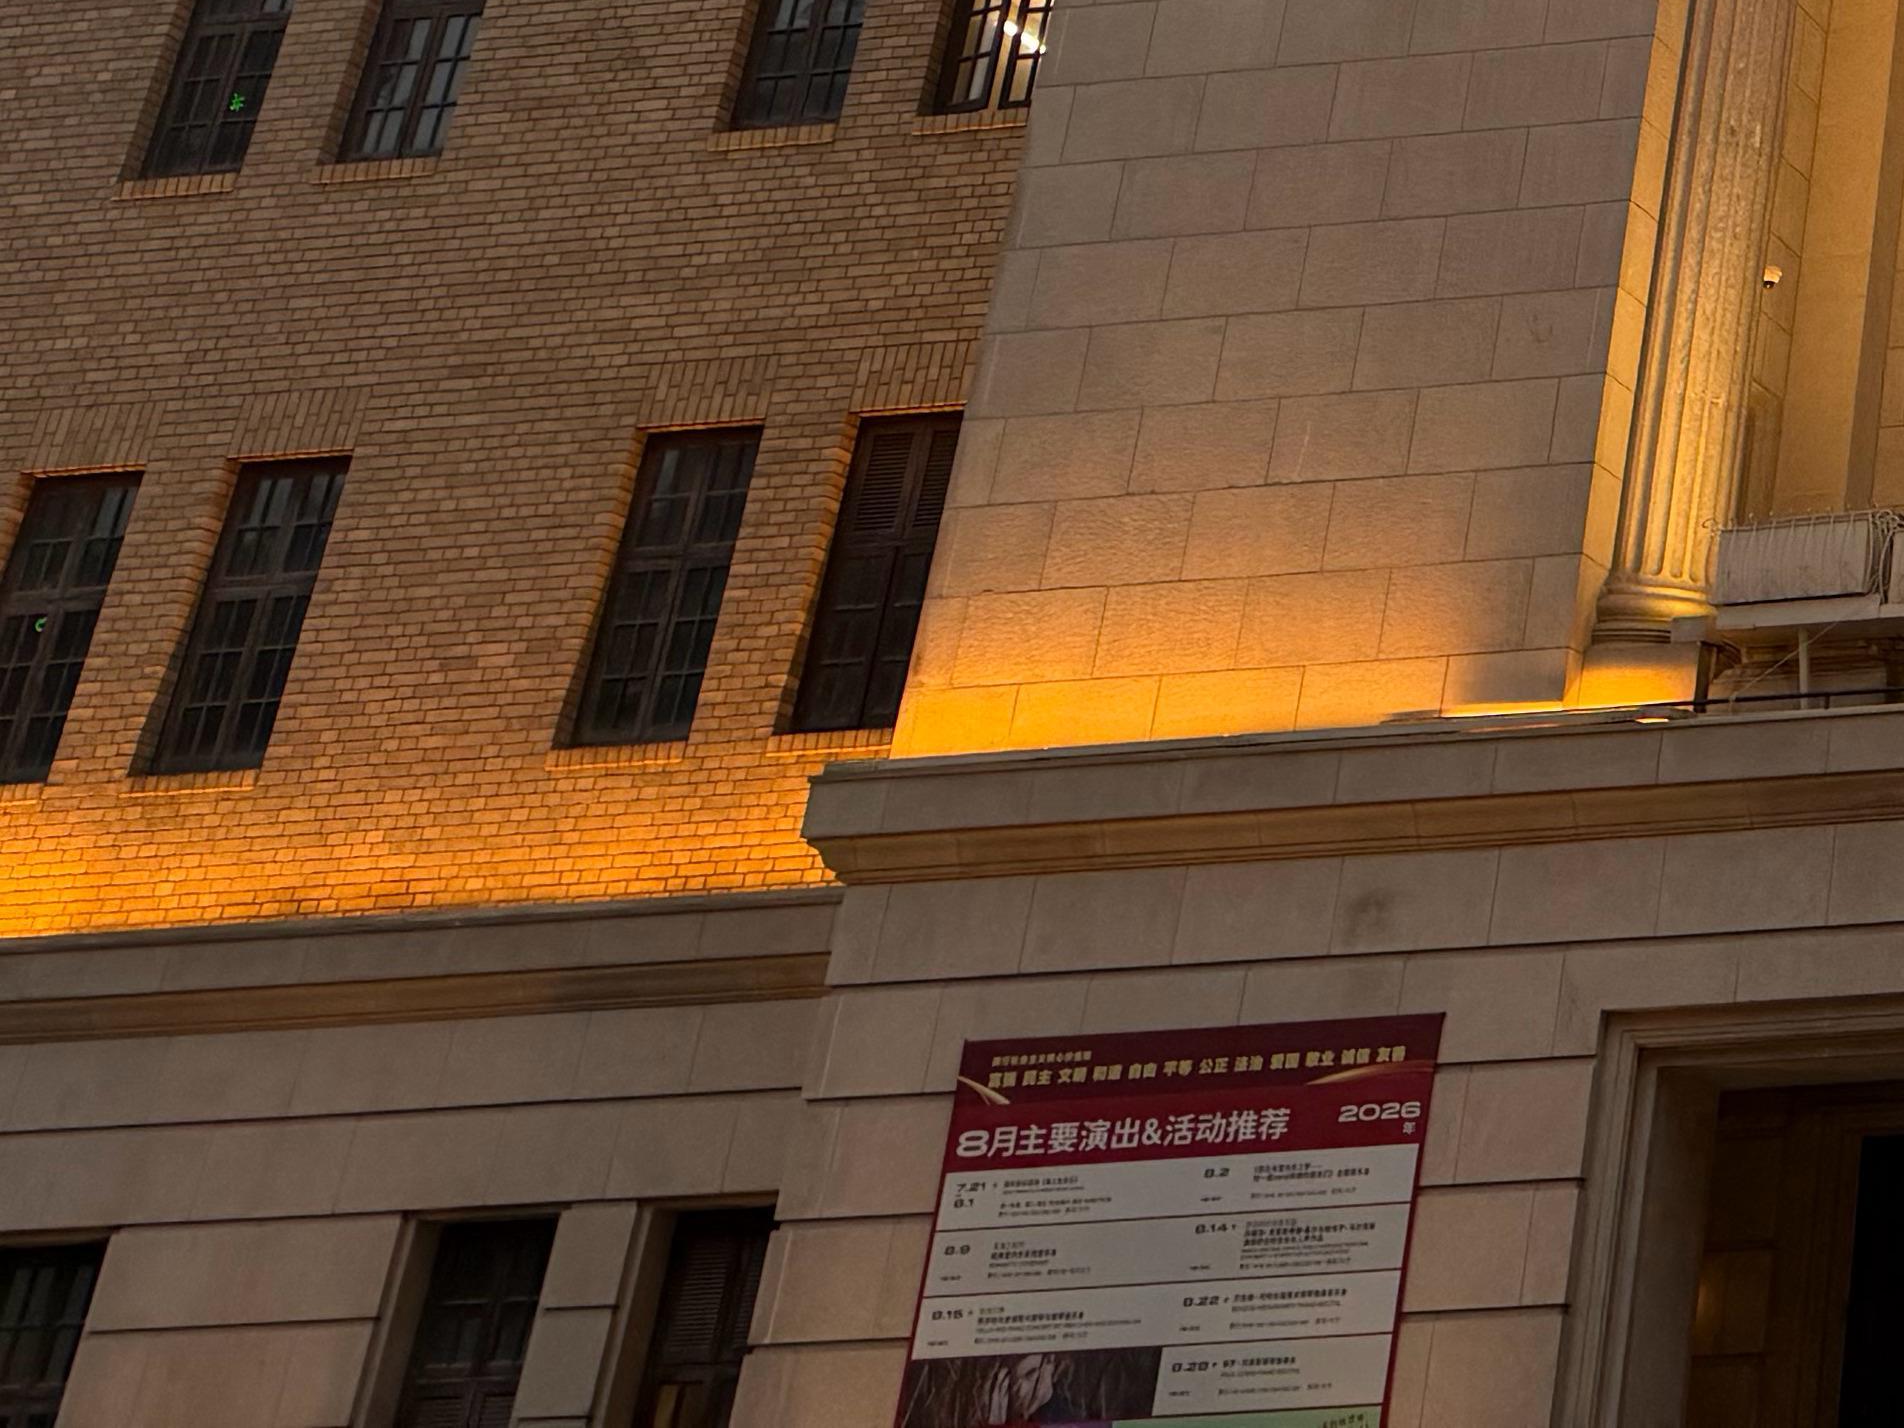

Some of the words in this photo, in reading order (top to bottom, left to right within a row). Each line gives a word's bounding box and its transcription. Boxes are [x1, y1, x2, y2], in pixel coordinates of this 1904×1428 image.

[1338, 1102, 1420, 1122] 2026
[956, 1108, 1292, 1159] 8月主要演出&活动推荐
